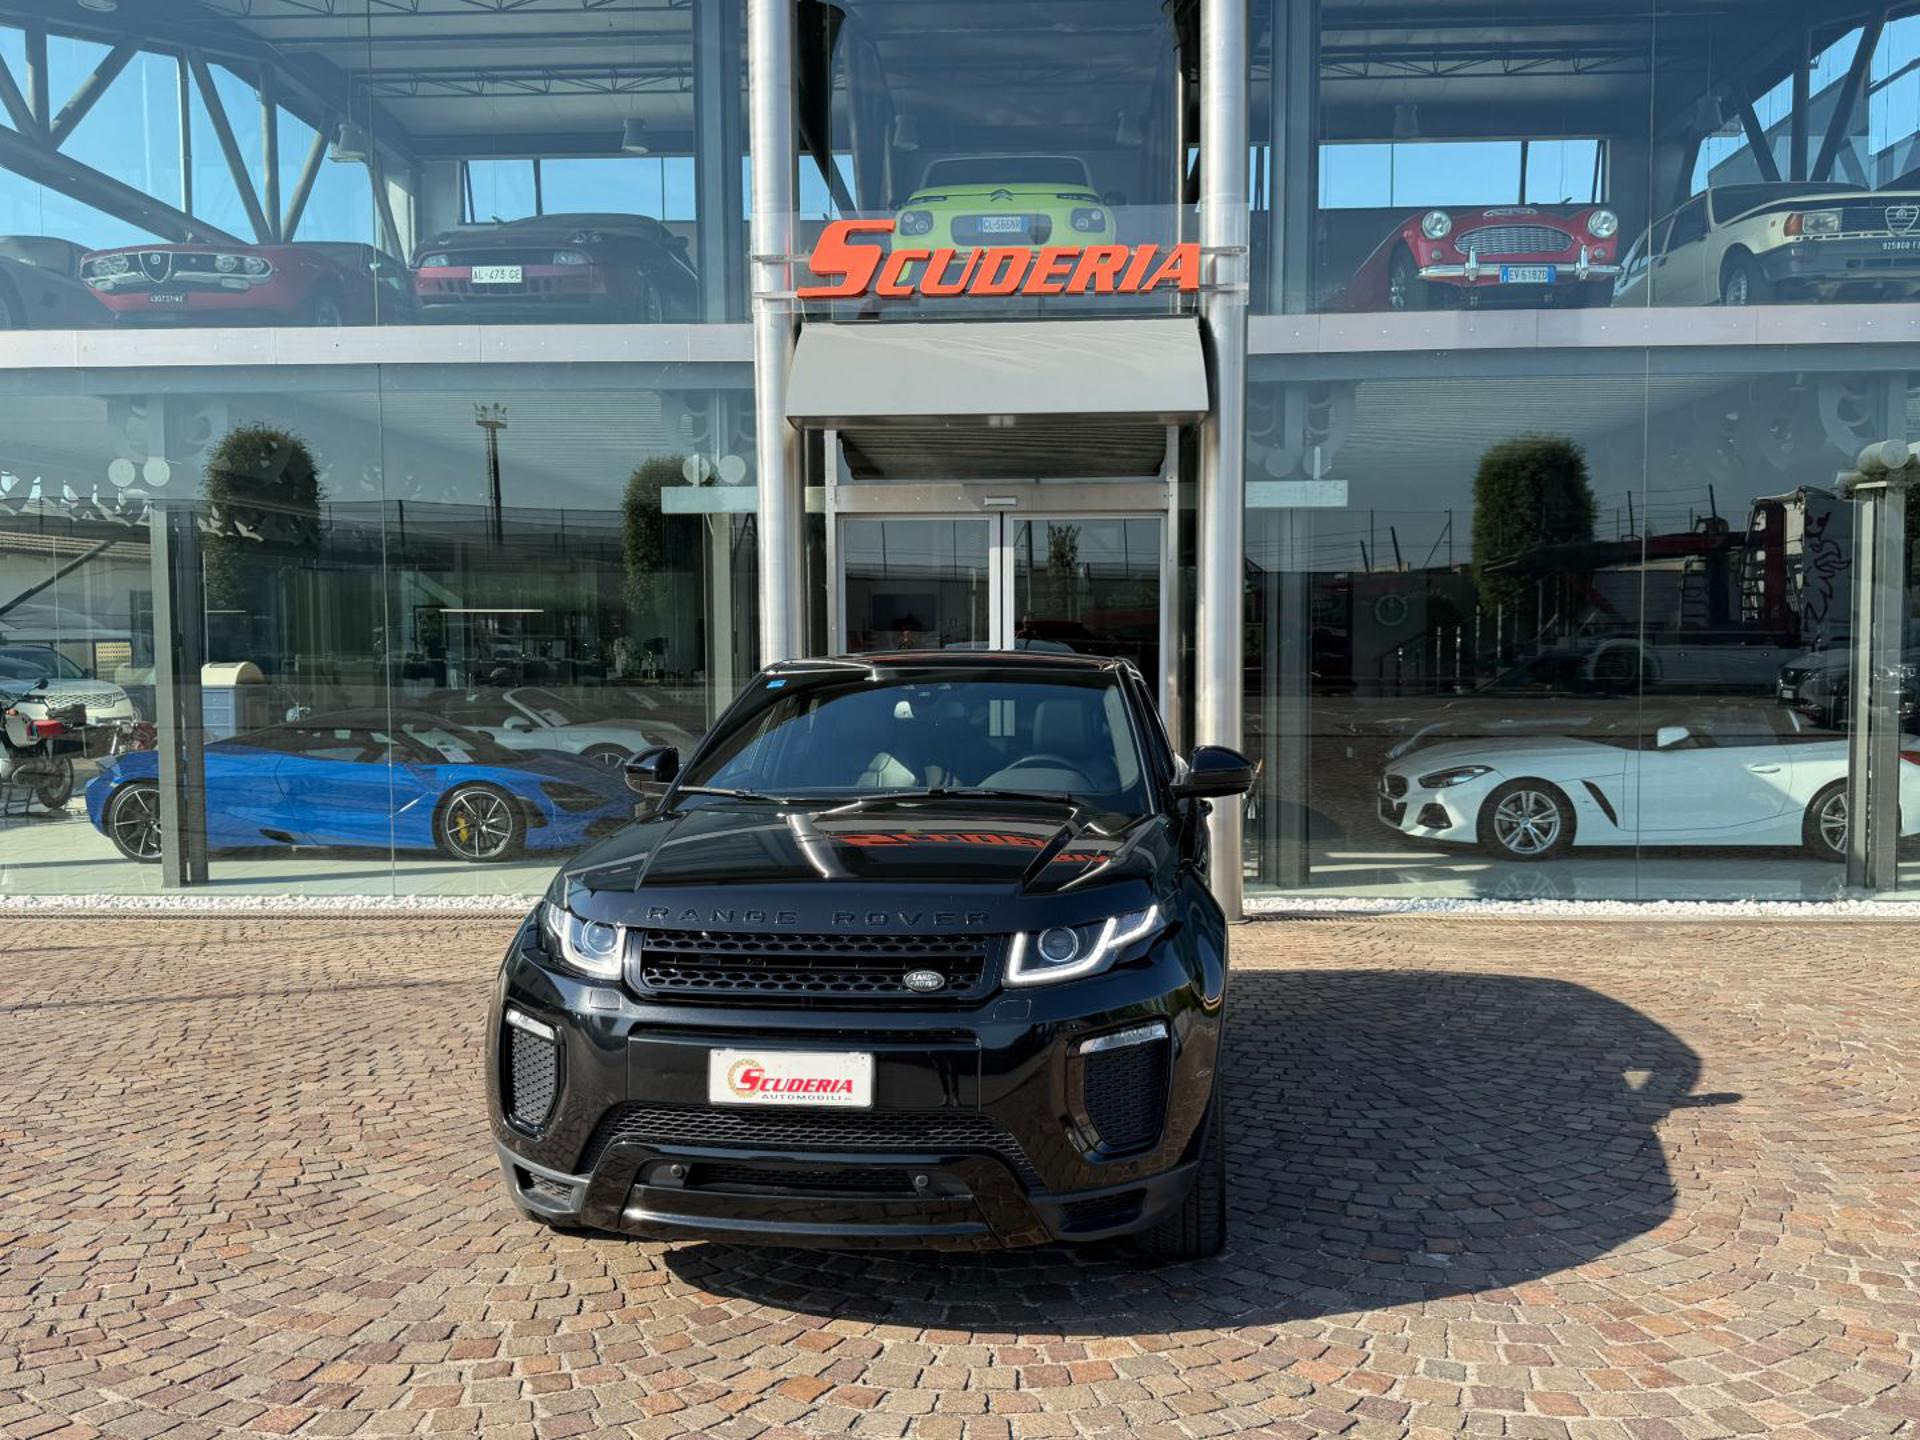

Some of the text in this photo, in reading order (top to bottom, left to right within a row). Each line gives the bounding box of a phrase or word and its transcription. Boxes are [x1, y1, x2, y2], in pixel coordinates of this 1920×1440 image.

[797, 219, 1201, 298] SCUDERIA
[646, 906, 991, 926] RANGE ROVER
[735, 1068, 854, 1094] SCUDERIA
[761, 1093, 842, 1101] AUTOMOBILI
